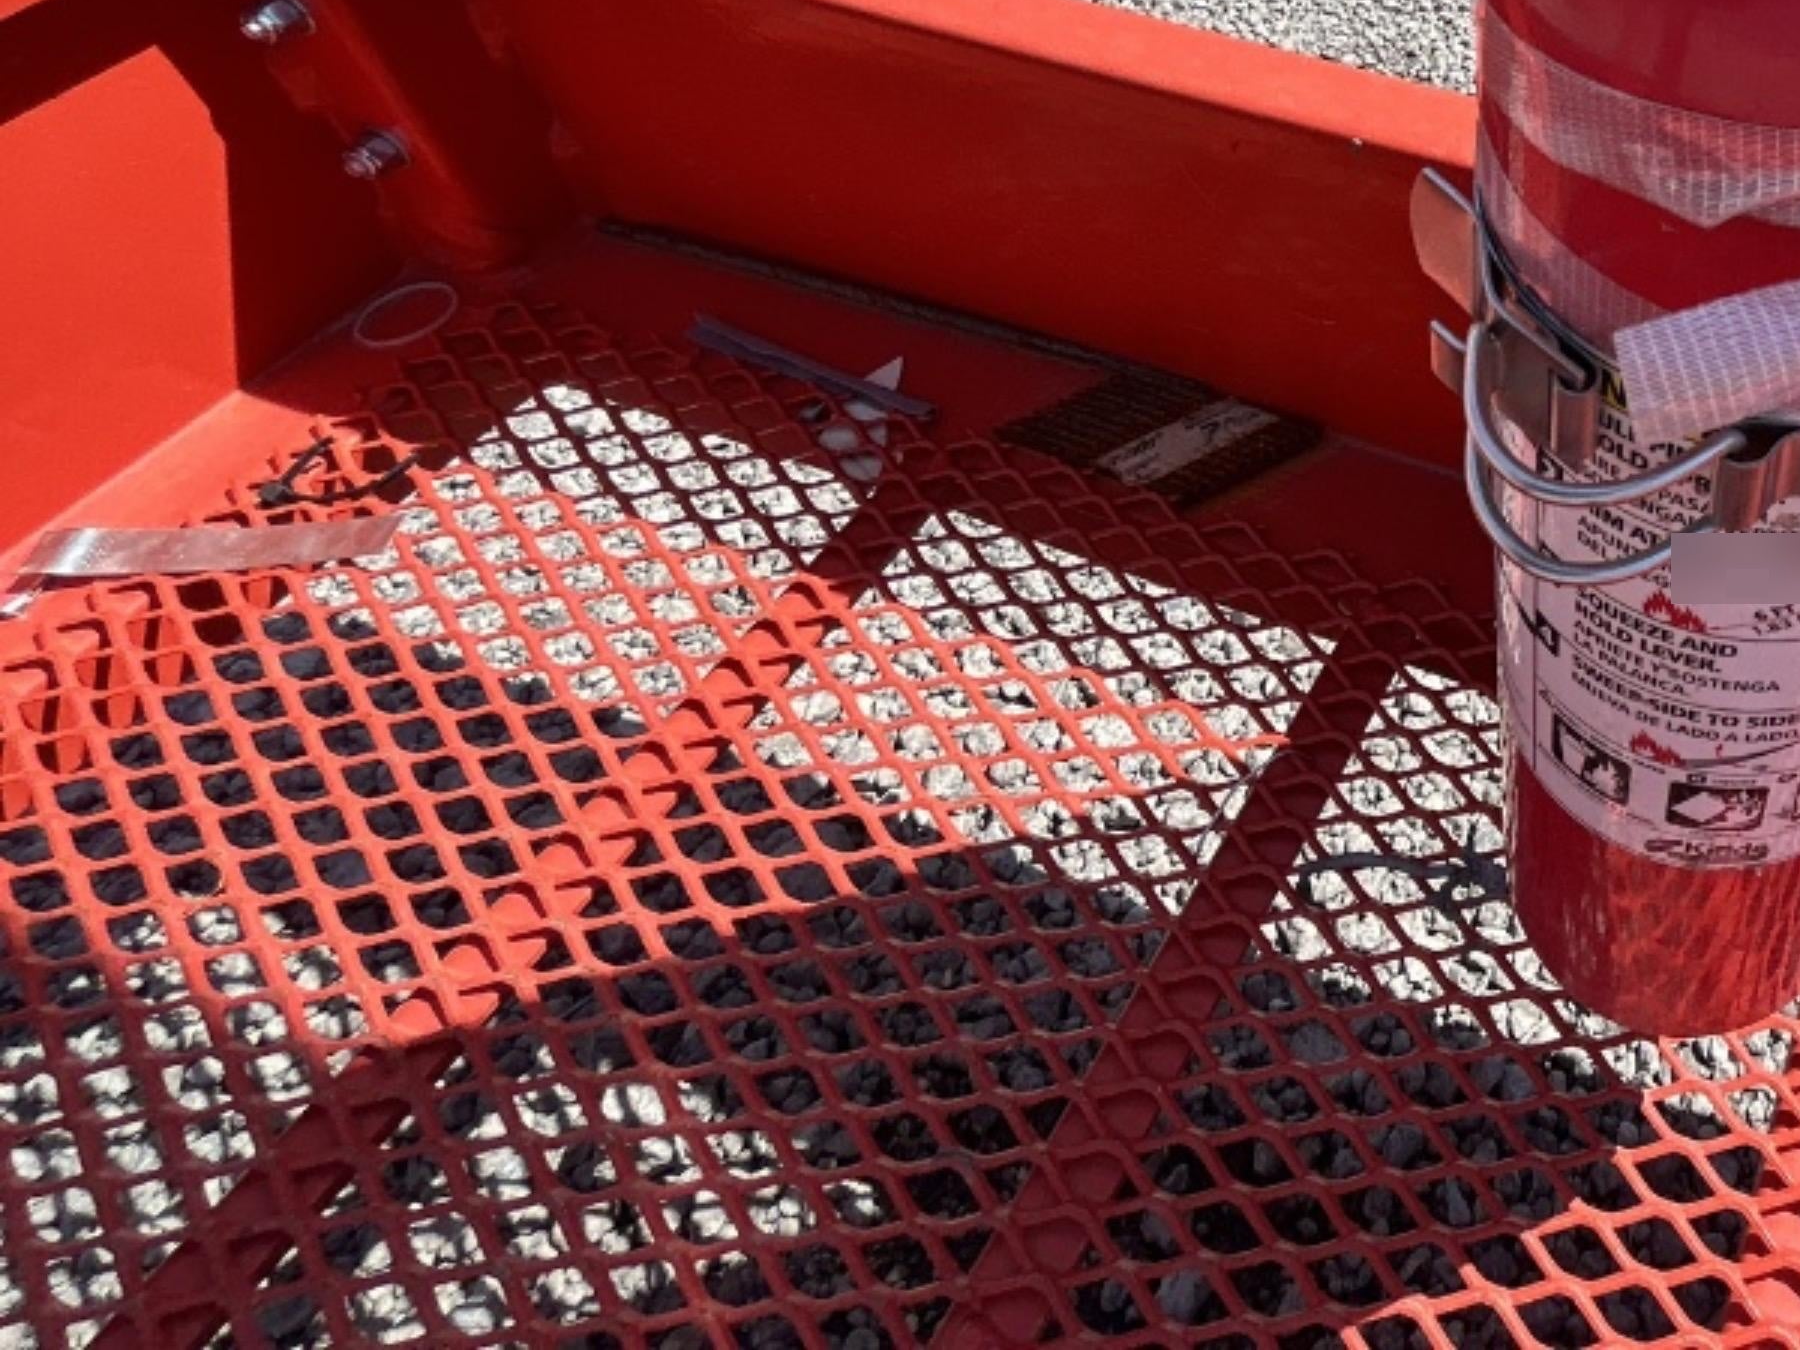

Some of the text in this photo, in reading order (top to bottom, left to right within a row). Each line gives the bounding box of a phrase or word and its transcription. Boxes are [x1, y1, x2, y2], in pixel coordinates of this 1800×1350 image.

[1575, 600, 1722, 673] HOLD LEVER.
[1577, 586, 1738, 658] SQUEEZE AND
[1666, 667, 1780, 693] SOSTENGA
[1647, 697, 1703, 724] SIDE
[1708, 712, 1740, 728] TO
[1666, 720, 1721, 742] LADO
[1724, 731, 1740, 743] A
